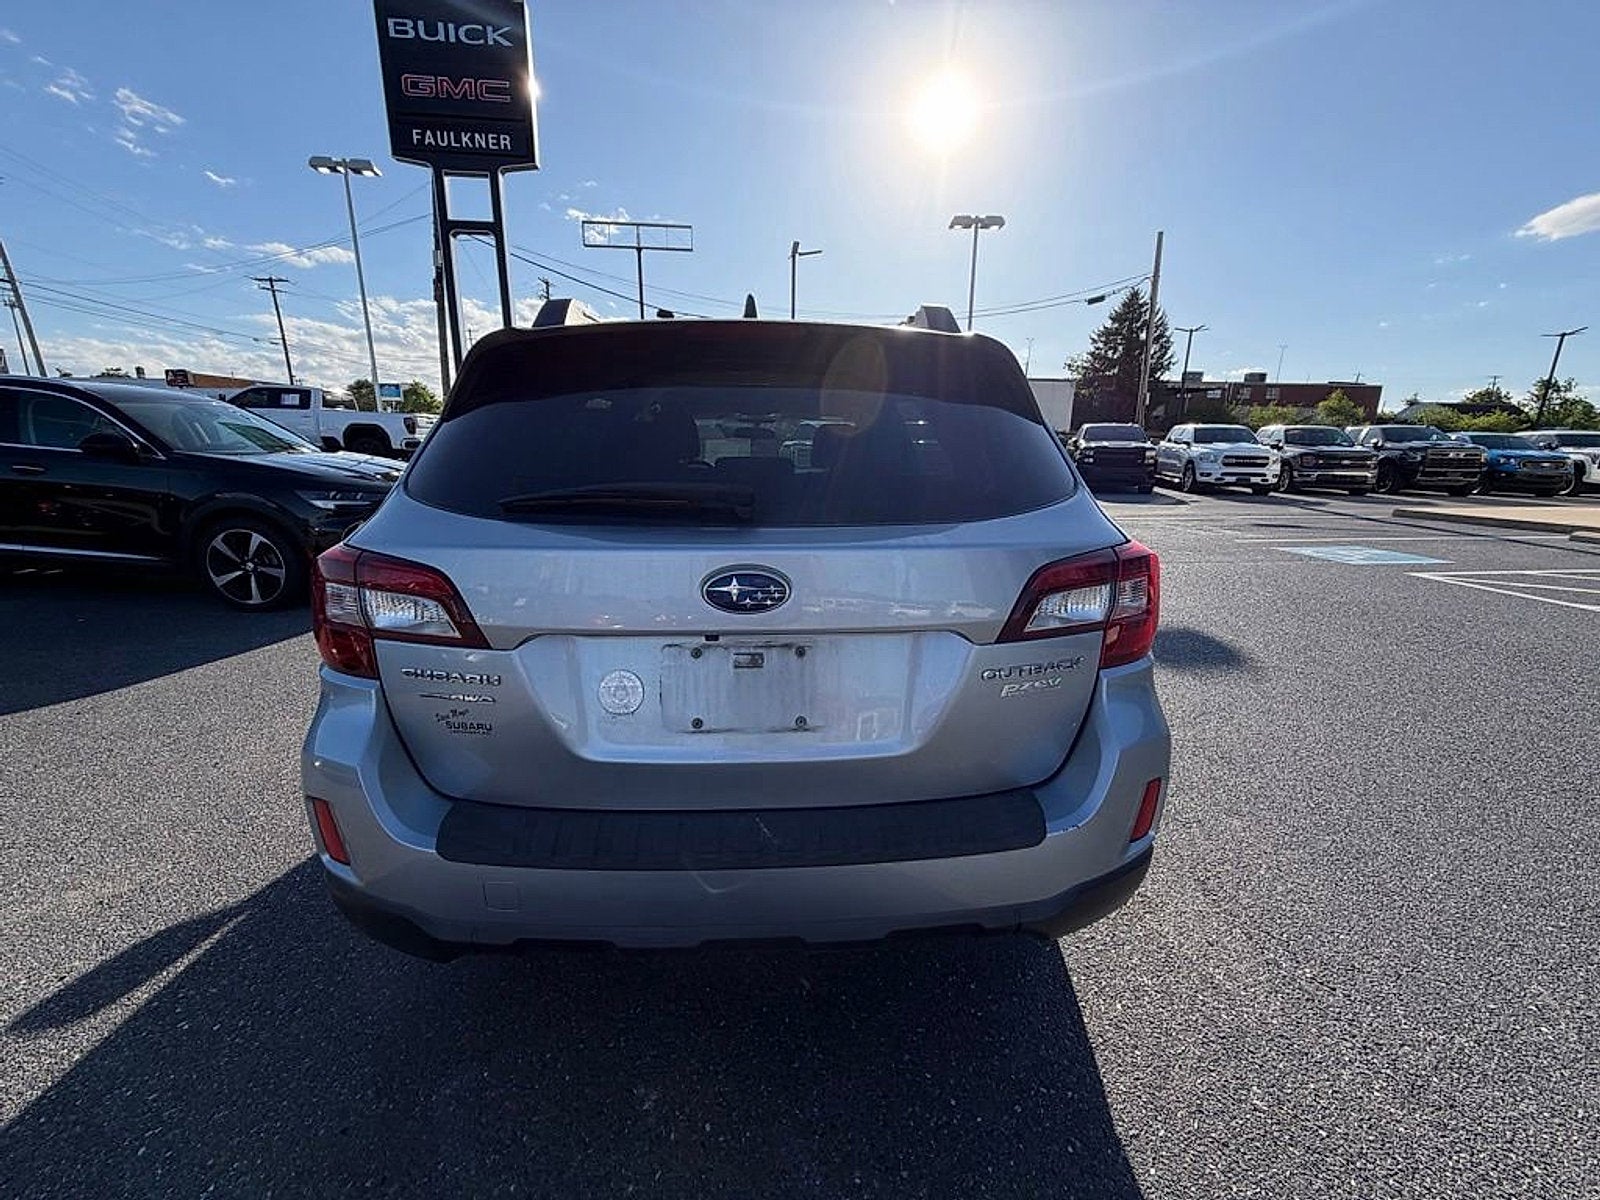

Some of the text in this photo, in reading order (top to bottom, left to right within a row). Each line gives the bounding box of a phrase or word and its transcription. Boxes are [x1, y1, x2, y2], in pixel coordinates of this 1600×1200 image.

[388, 17, 513, 47] BUICK
[401, 73, 510, 103] GMC
[412, 129, 511, 150] FAULKNER
[401, 668, 500, 686] SUBARU
[981, 655, 1084, 680] OUTBACK
[446, 721, 492, 731] SUBARU
